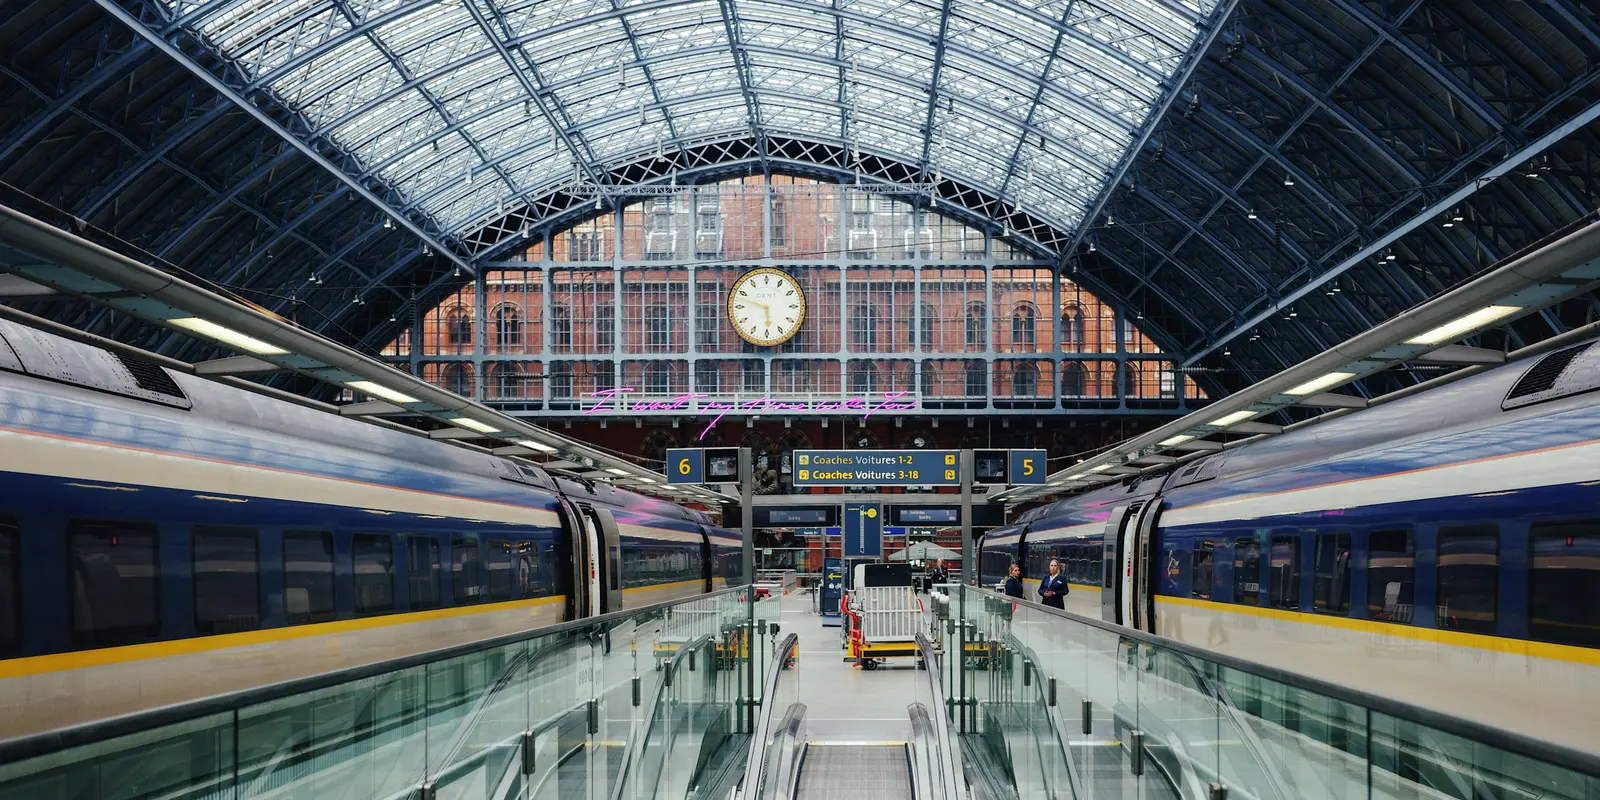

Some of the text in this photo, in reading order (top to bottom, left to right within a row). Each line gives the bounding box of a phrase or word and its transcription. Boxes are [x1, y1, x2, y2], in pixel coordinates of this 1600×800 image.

[583, 388, 634, 415] I
[678, 457, 691, 476] 6
[813, 455, 913, 465] Coaches Voitures 1-2
[1023, 458, 1034, 476] 5
[813, 470, 919, 480] Coaches Voitures 3-18
